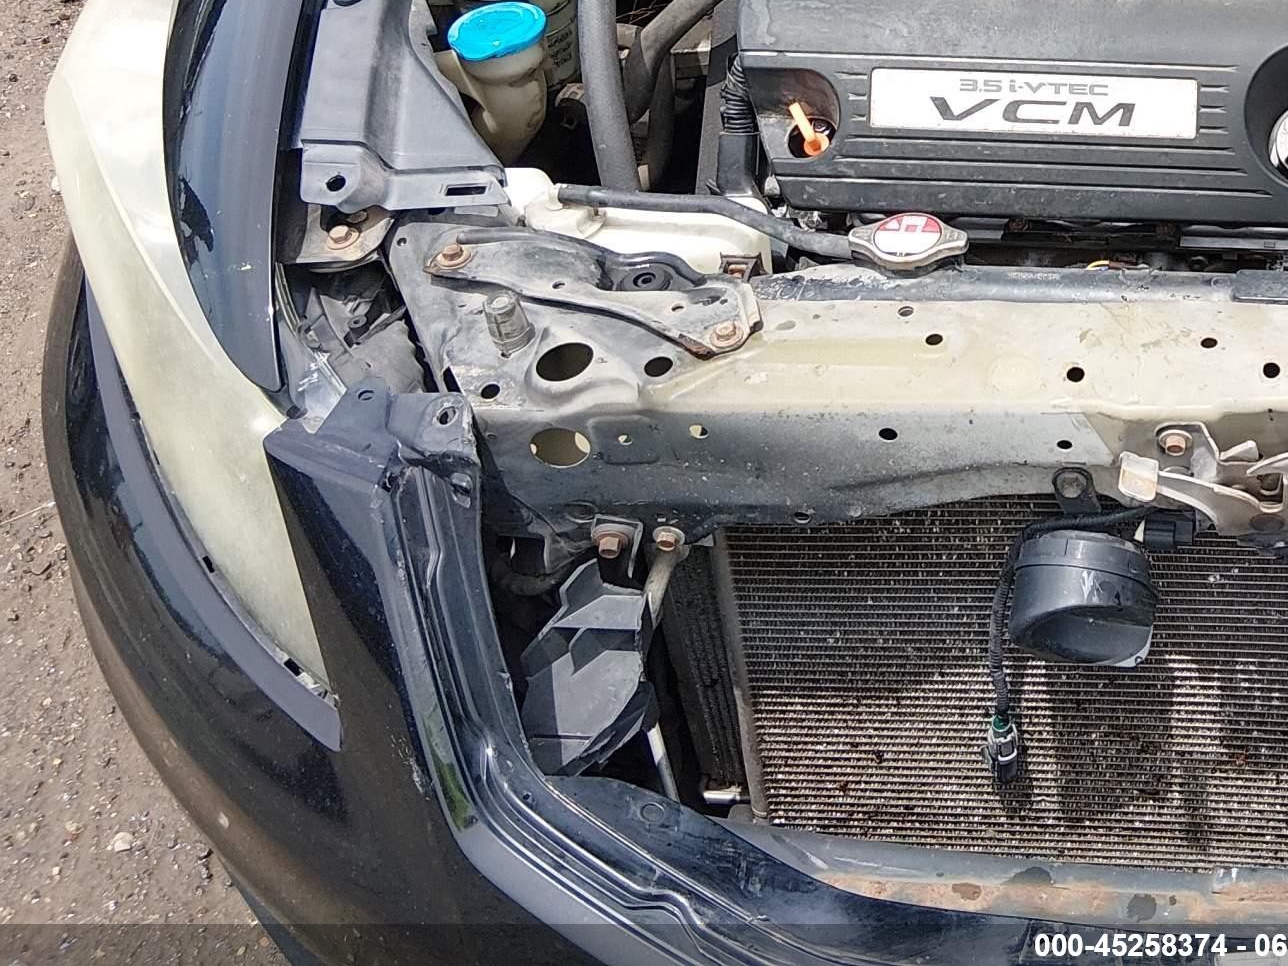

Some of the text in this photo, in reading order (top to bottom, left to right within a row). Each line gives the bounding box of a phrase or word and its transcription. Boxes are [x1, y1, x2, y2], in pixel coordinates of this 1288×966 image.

[959, 78, 1109, 97] 3.5 i-VTEC
[929, 96, 1137, 127] VCM
